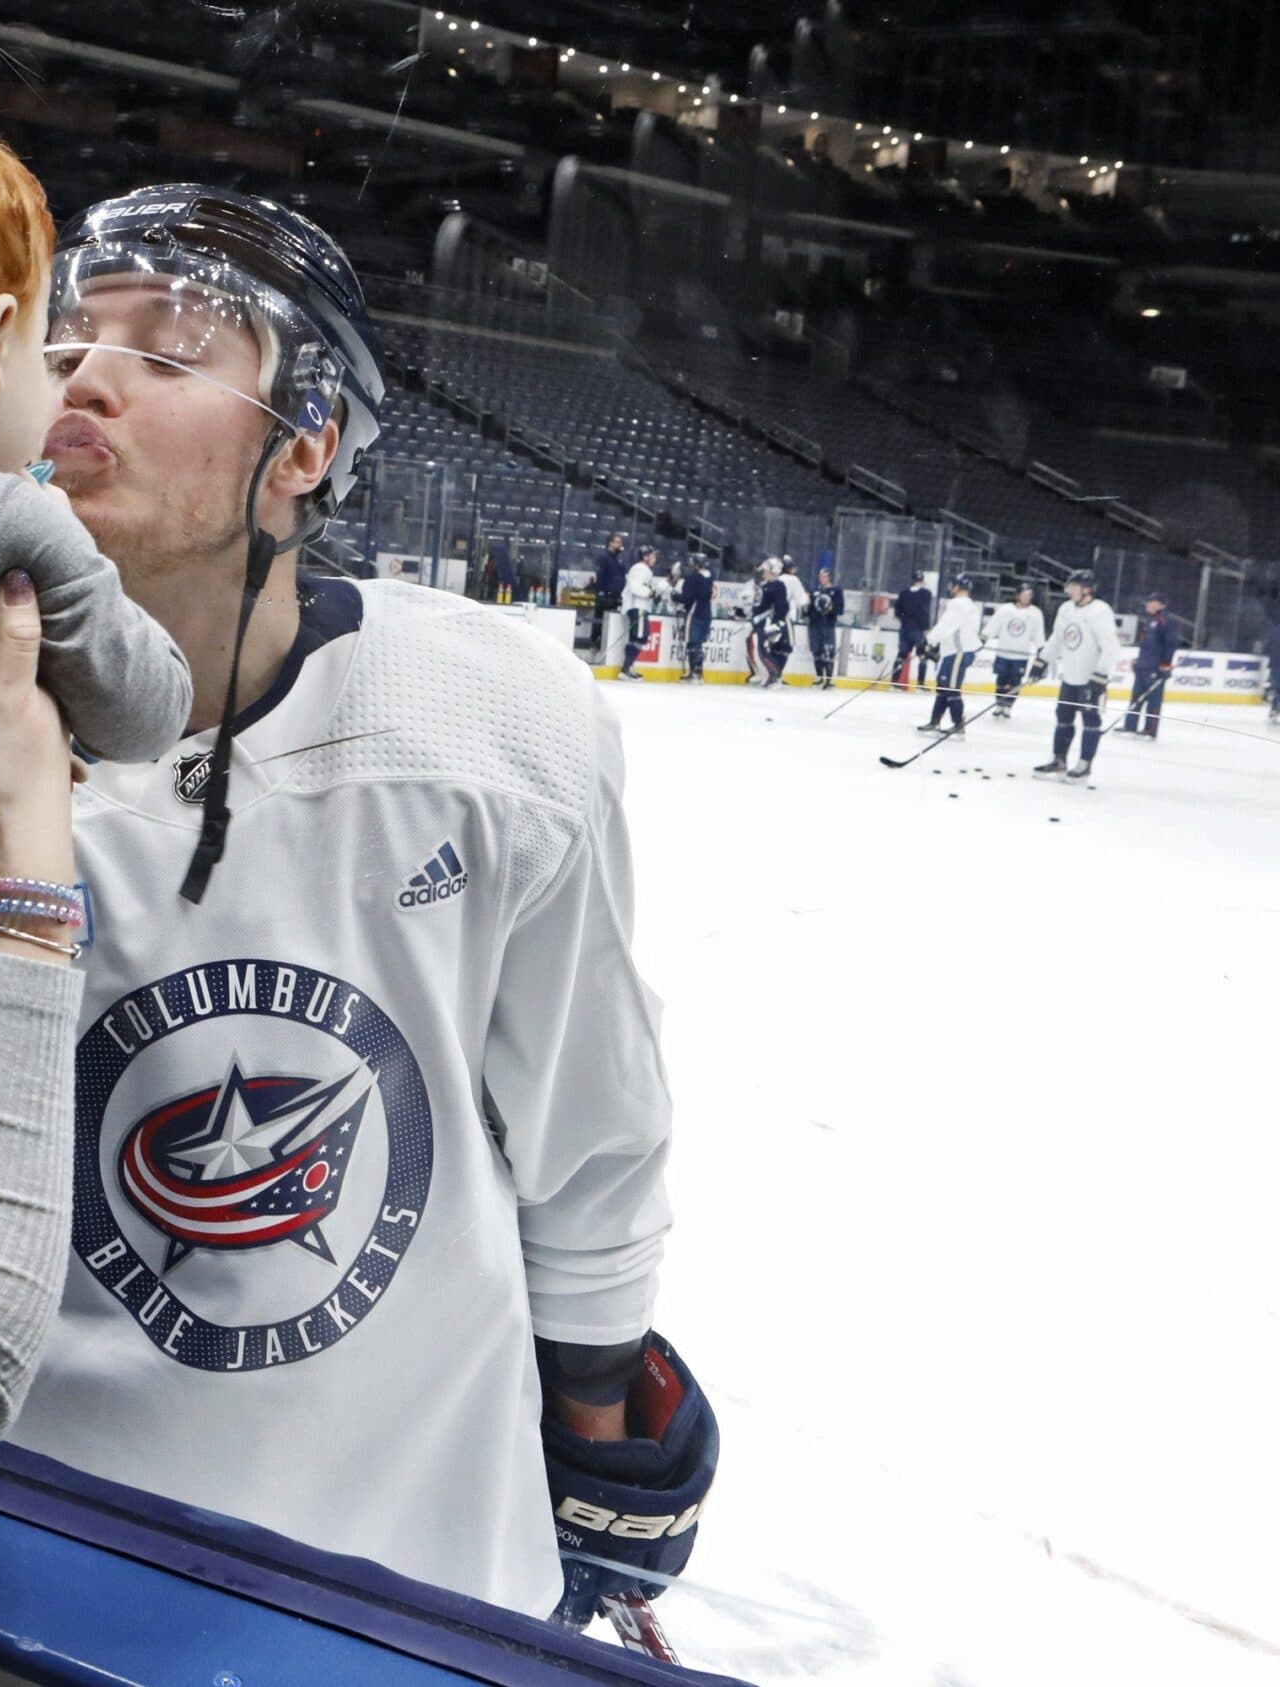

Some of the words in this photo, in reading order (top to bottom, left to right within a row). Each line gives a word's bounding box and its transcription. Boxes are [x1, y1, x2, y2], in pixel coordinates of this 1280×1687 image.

[91, 202, 188, 223] AUER
[398, 872, 468, 908] adidas
[103, 963, 360, 1054] COLUMBUS
[85, 1237, 194, 1356] BLUE
[226, 1204, 418, 1370] JACKETS
